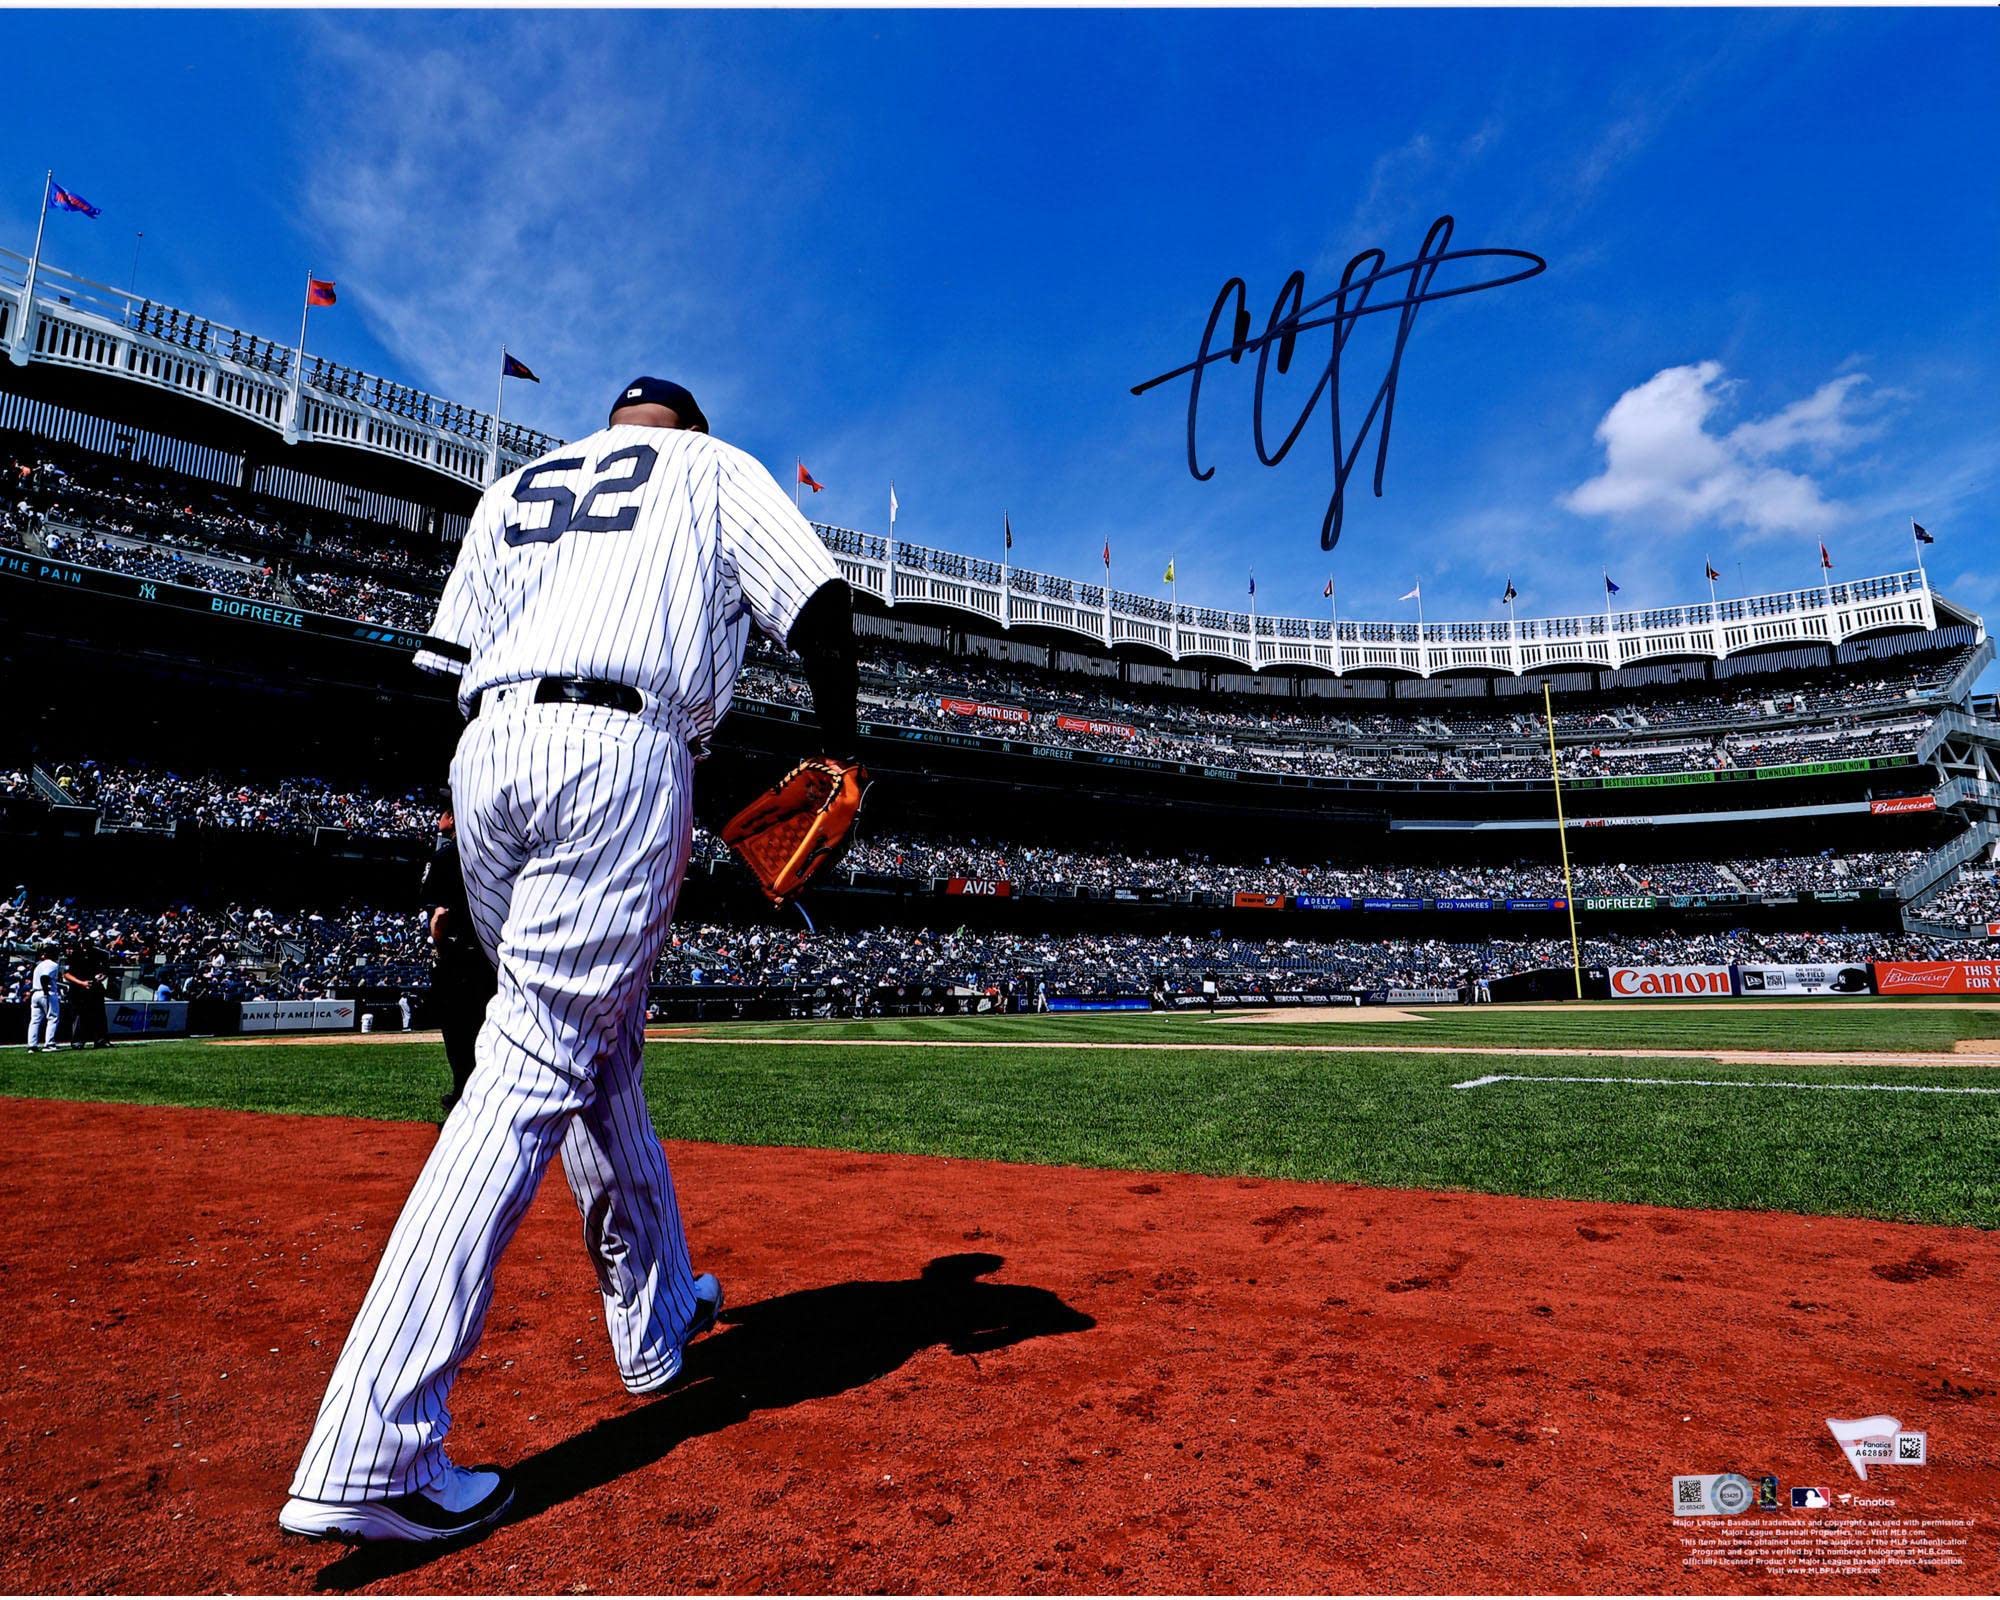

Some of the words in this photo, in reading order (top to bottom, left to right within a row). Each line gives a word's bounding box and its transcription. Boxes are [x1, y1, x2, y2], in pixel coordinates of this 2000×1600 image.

[504, 445, 658, 547] 52
[41, 566, 81, 583] PAIN
[977, 705, 1002, 718] PARTY
[1003, 708, 1024, 720] DECK
[1089, 722, 1111, 735] PARTY
[1112, 726, 1131, 737] DECK
[963, 737, 981, 747] PAIN
[1758, 766, 1796, 779] DOWNLOAD
[1799, 765, 1810, 776] THE
[1828, 761, 1847, 772] BOOK
[1850, 759, 1866, 769] NOW
[1605, 776, 1620, 787] BEST
[1646, 775, 1660, 786] LAST
[1663, 774, 1687, 785] MINUTE
[1874, 801, 1934, 814] Budweiser
[962, 880, 996, 895] AVIS
[1813, 890, 1837, 900] Poland
[1837, 889, 1860, 899] Spring
[1265, 897, 1277, 905] SAP
[1437, 901, 1454, 909] (212)
[1455, 901, 1489, 909] YANKEES
[1963, 965, 1993, 976] THIS
[1612, 969, 1730, 995] Canon
[1889, 972, 1949, 983] Budweiser
[1966, 977, 1992, 988] FOR
[243, 1012, 270, 1020] BANK
[273, 1011, 286, 1019] OF
[288, 1010, 332, 1019] AMERICA
[1863, 1440, 1892, 1449] Fanatics
[1855, 1449, 1893, 1457] A628597
